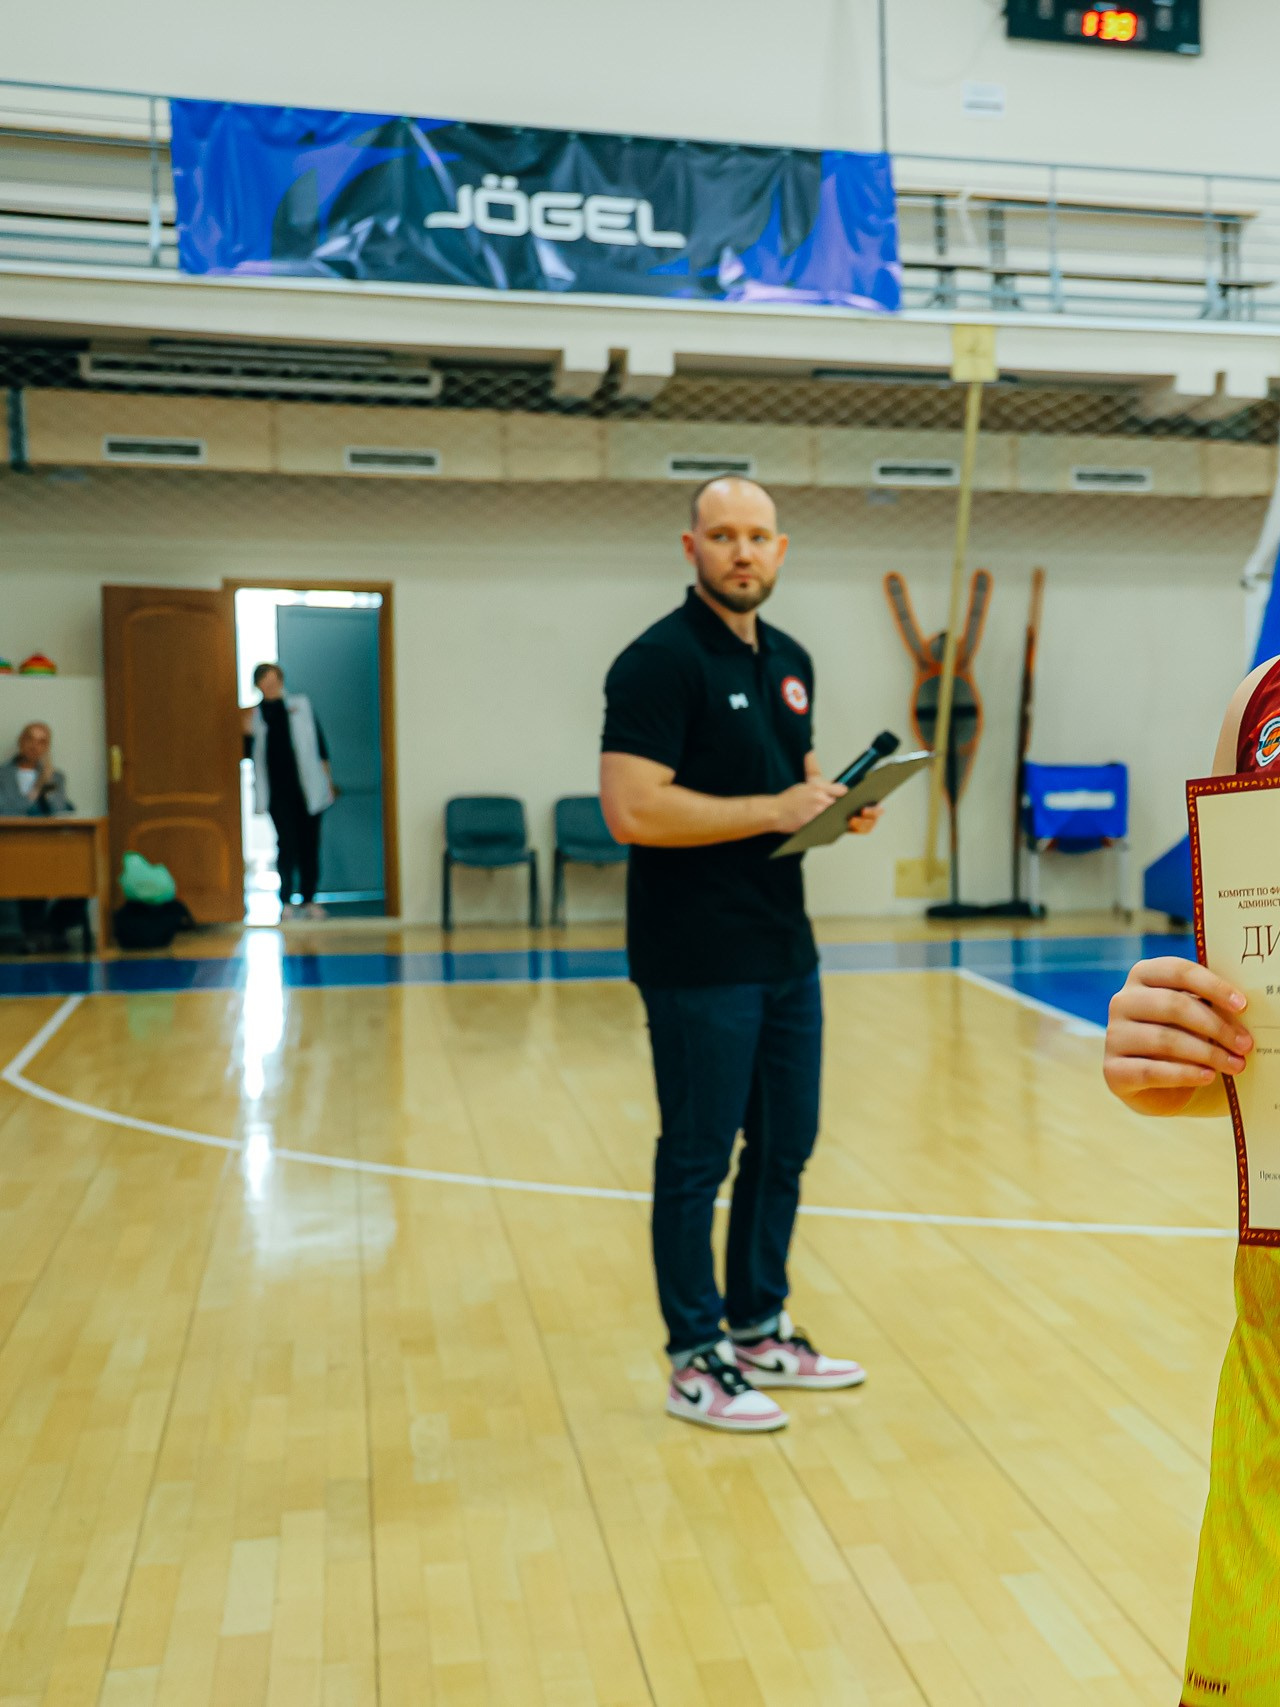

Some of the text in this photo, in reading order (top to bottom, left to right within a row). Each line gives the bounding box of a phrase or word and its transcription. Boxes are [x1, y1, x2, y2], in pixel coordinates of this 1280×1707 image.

[424, 174, 687, 249] JÖGEL
[1218, 887, 1255, 898] КОМИТЕТ
[1256, 887, 1269, 896] ПО
